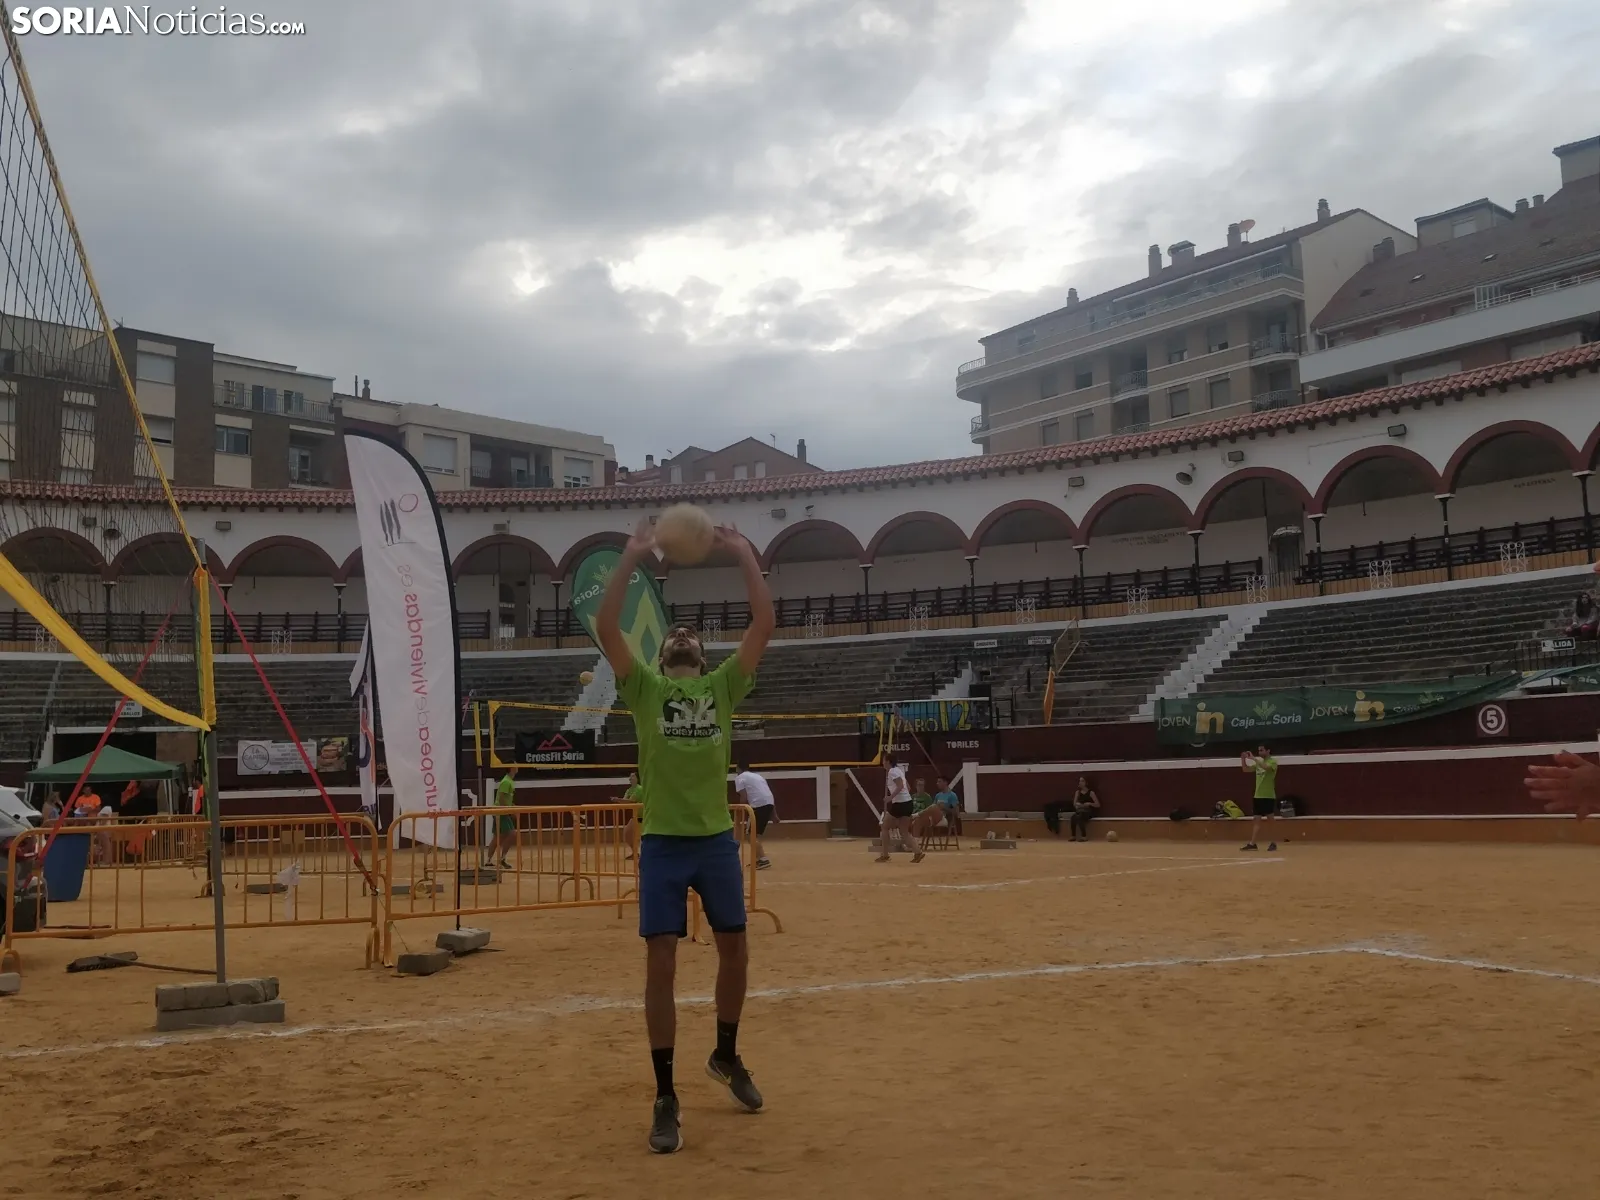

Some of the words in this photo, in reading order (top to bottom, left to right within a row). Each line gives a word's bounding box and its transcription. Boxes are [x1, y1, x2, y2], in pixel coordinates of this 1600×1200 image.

[1544, 639, 1573, 648] ALIDA
[1157, 715, 1191, 731] JOVEN
[1195, 702, 1225, 734] in
[1230, 716, 1255, 729] Caja
[1272, 713, 1302, 725] Soria
[1310, 704, 1349, 720] JOVEN
[1486, 709, 1498, 729] 5
[946, 740, 980, 749] TORILES
[525, 752, 561, 763] CrossFit
[562, 750, 585, 762] Soria
